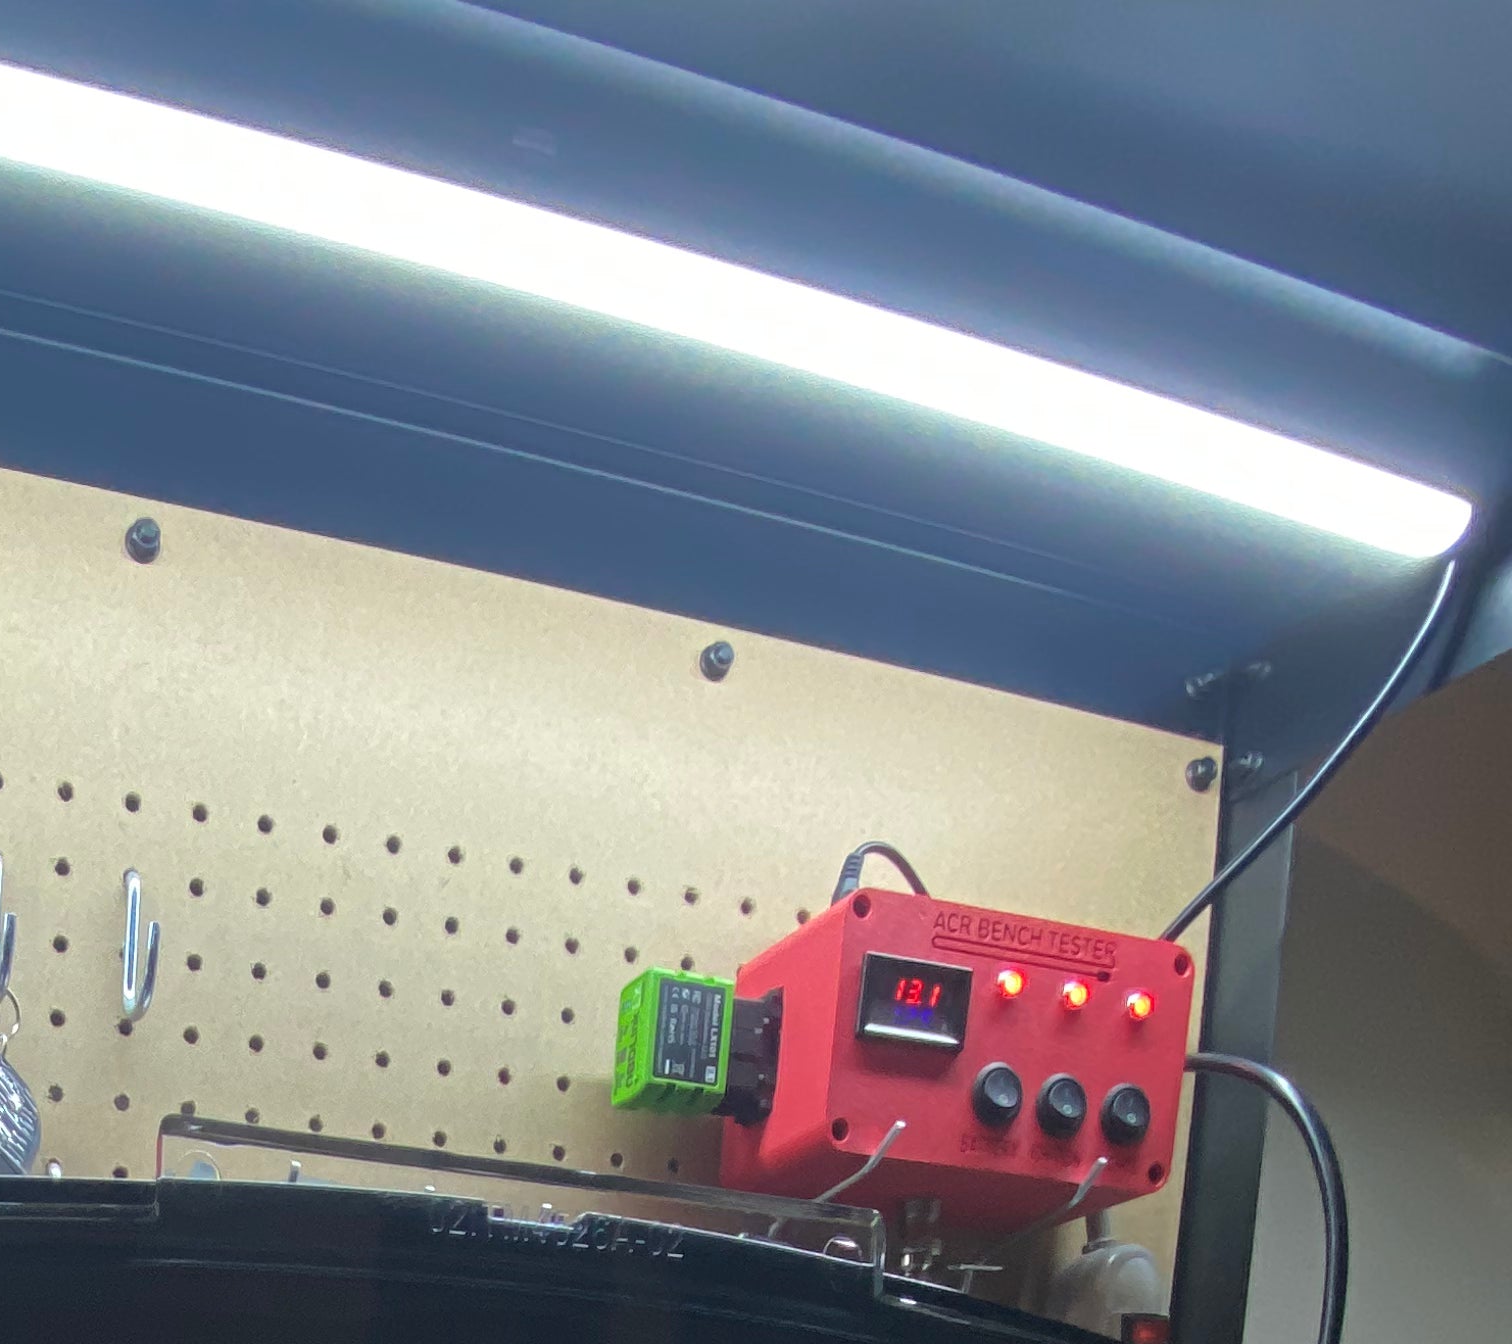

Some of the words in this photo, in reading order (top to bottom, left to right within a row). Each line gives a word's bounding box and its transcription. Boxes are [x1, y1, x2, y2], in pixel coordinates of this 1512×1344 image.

[933, 913, 971, 936] ACR
[978, 919, 1042, 947] BENCH
[1050, 930, 1116, 960] TESTER
